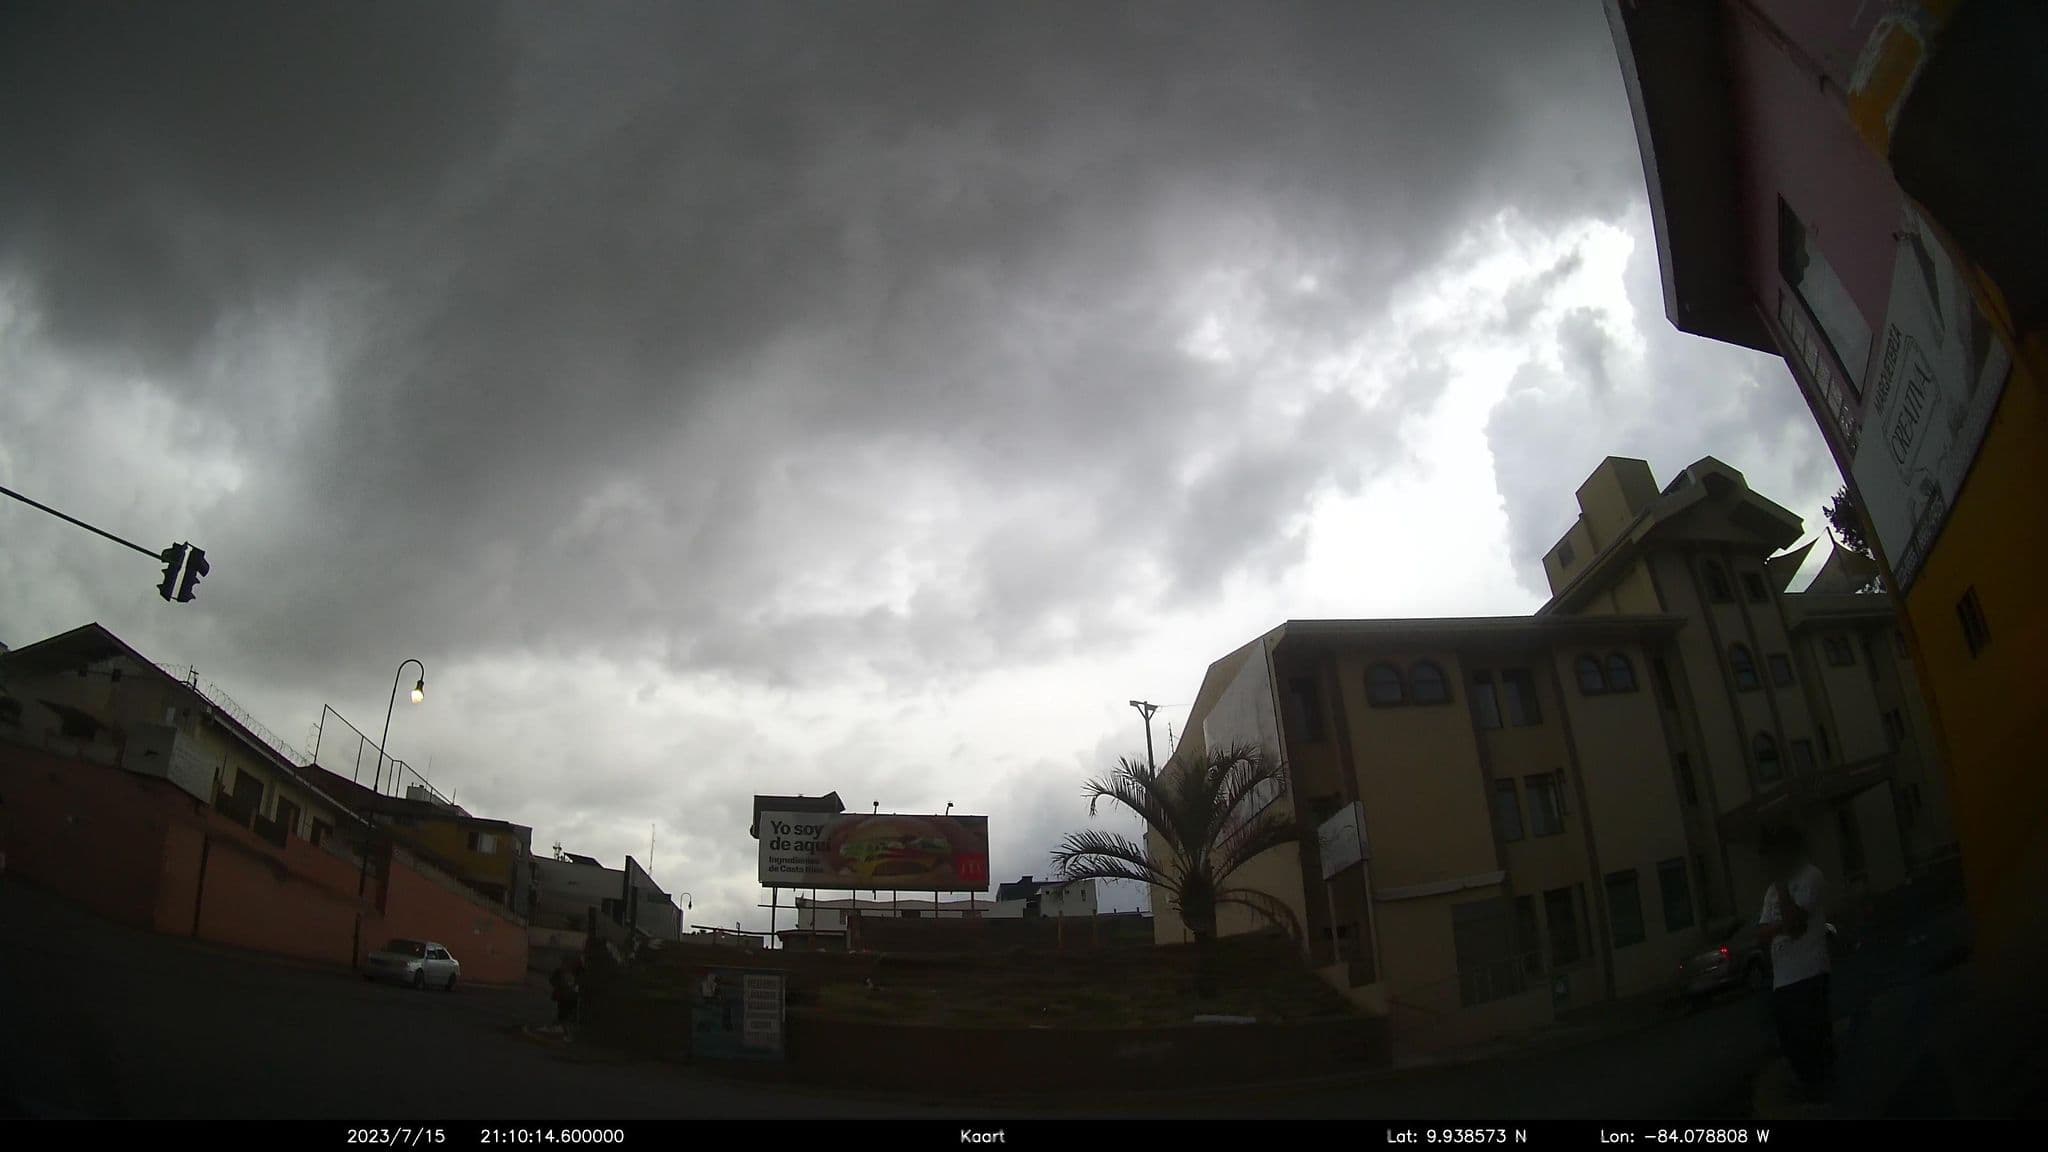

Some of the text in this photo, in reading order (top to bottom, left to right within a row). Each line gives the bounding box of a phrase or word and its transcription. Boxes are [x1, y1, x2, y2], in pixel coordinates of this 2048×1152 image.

[1890, 360, 1933, 465] CREATIVA
[770, 820, 825, 840] Yo soy
[769, 836, 791, 851] de
